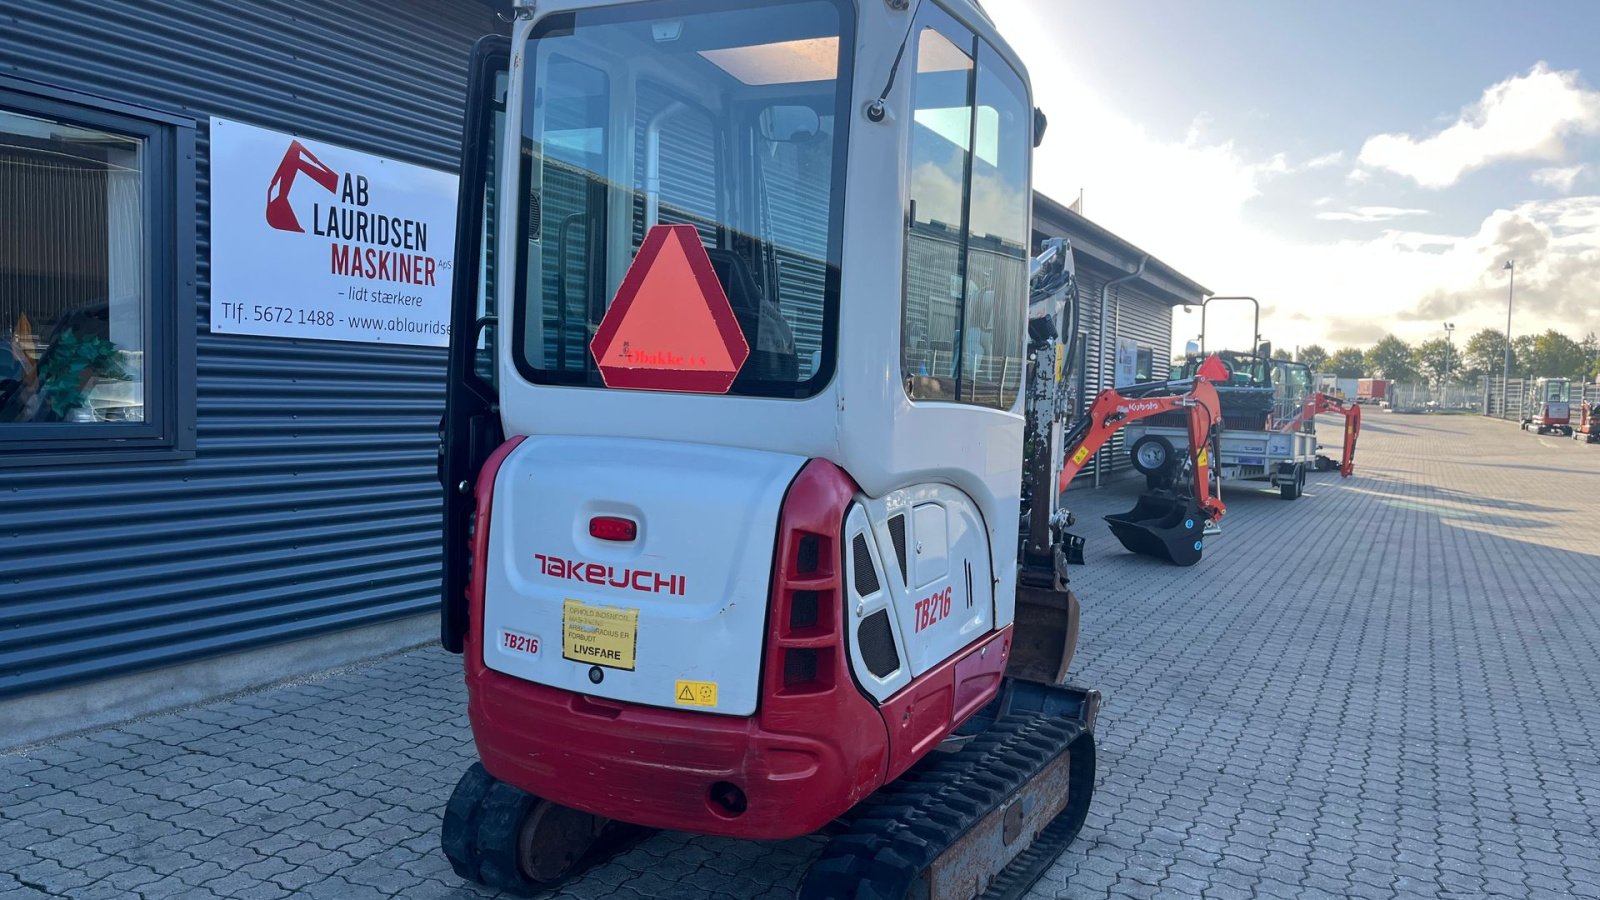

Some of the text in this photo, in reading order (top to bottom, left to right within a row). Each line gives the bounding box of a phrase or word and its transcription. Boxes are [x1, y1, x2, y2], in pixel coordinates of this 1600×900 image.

[341, 172, 369, 207] AB
[313, 203, 427, 252] LAURIDSEN
[331, 243, 452, 287] MASKINER ApS
[348, 286, 369, 301] lidt
[371, 289, 423, 307] stærkere
[221, 302, 248, 324] Tlf.
[253, 305, 293, 324] 5672
[298, 309, 335, 327] 1488
[1128, 401, 1159, 411] Kubota
[534, 554, 686, 596] TAKEUCHI
[914, 586, 952, 634] TB216
[504, 632, 539, 654] TB216
[573, 643, 621, 660] LIVSFARE
